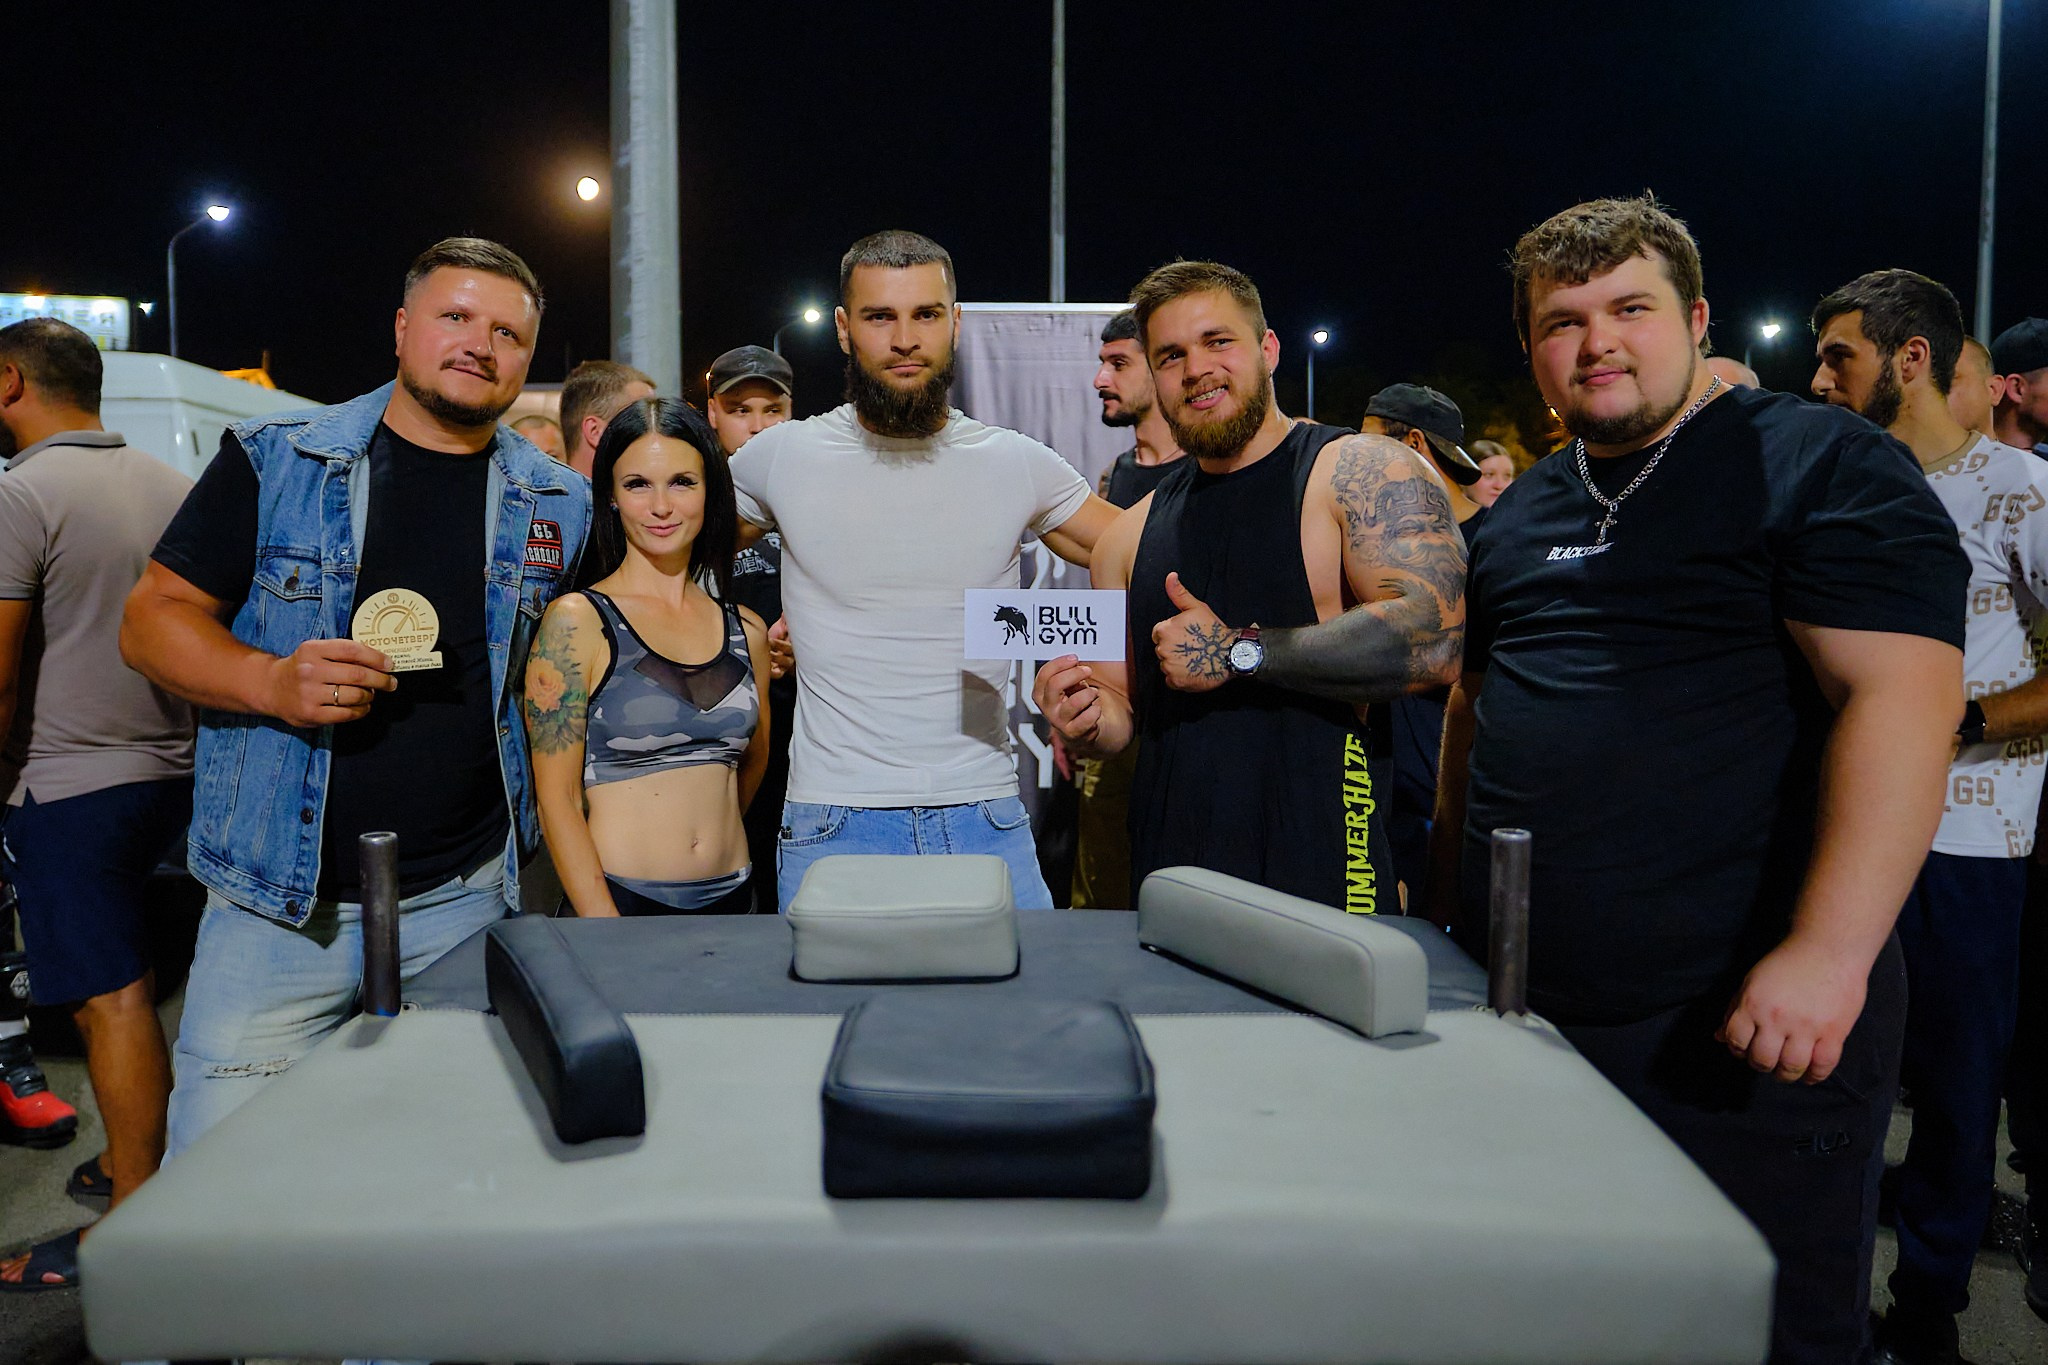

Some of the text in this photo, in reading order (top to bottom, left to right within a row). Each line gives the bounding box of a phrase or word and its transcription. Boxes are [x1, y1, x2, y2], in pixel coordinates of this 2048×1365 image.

[1038, 606, 1097, 626] BULL
[1038, 627, 1097, 646] GYM
[1343, 733, 1377, 916] UMMERHAZE
